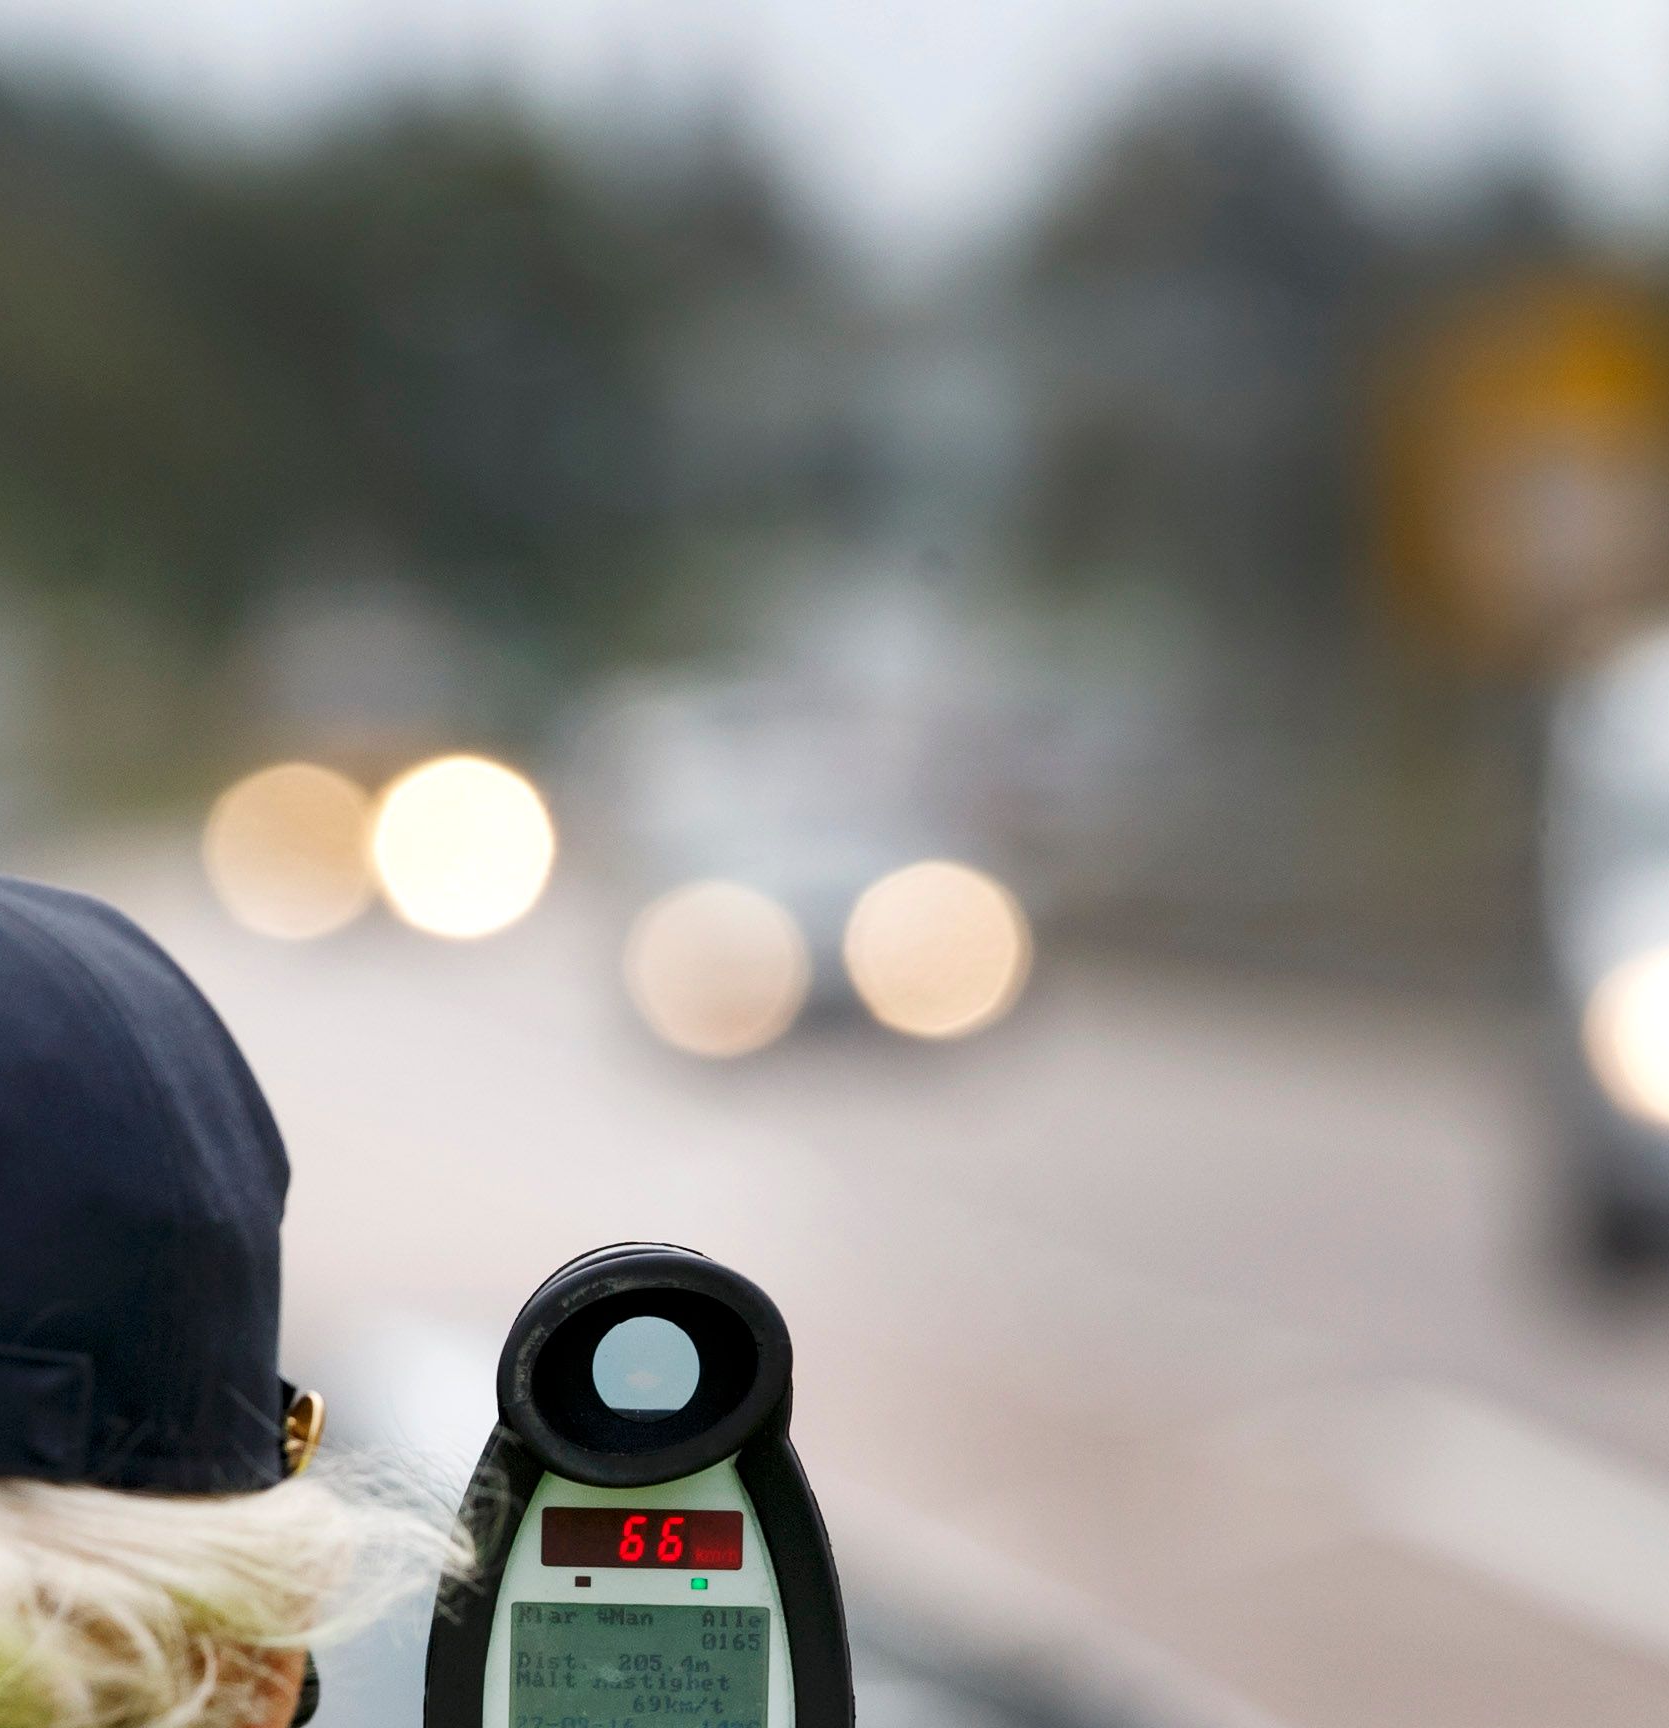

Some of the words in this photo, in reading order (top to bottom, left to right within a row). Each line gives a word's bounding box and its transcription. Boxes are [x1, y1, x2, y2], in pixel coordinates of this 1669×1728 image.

[619, 1515, 684, 1563] 66
[518, 1605, 577, 1624] Klar
[701, 1609, 761, 1629] Alle
[701, 1632, 761, 1651] 0165
[517, 1651, 588, 1671] Dist.
[517, 1669, 576, 1689] Målt
